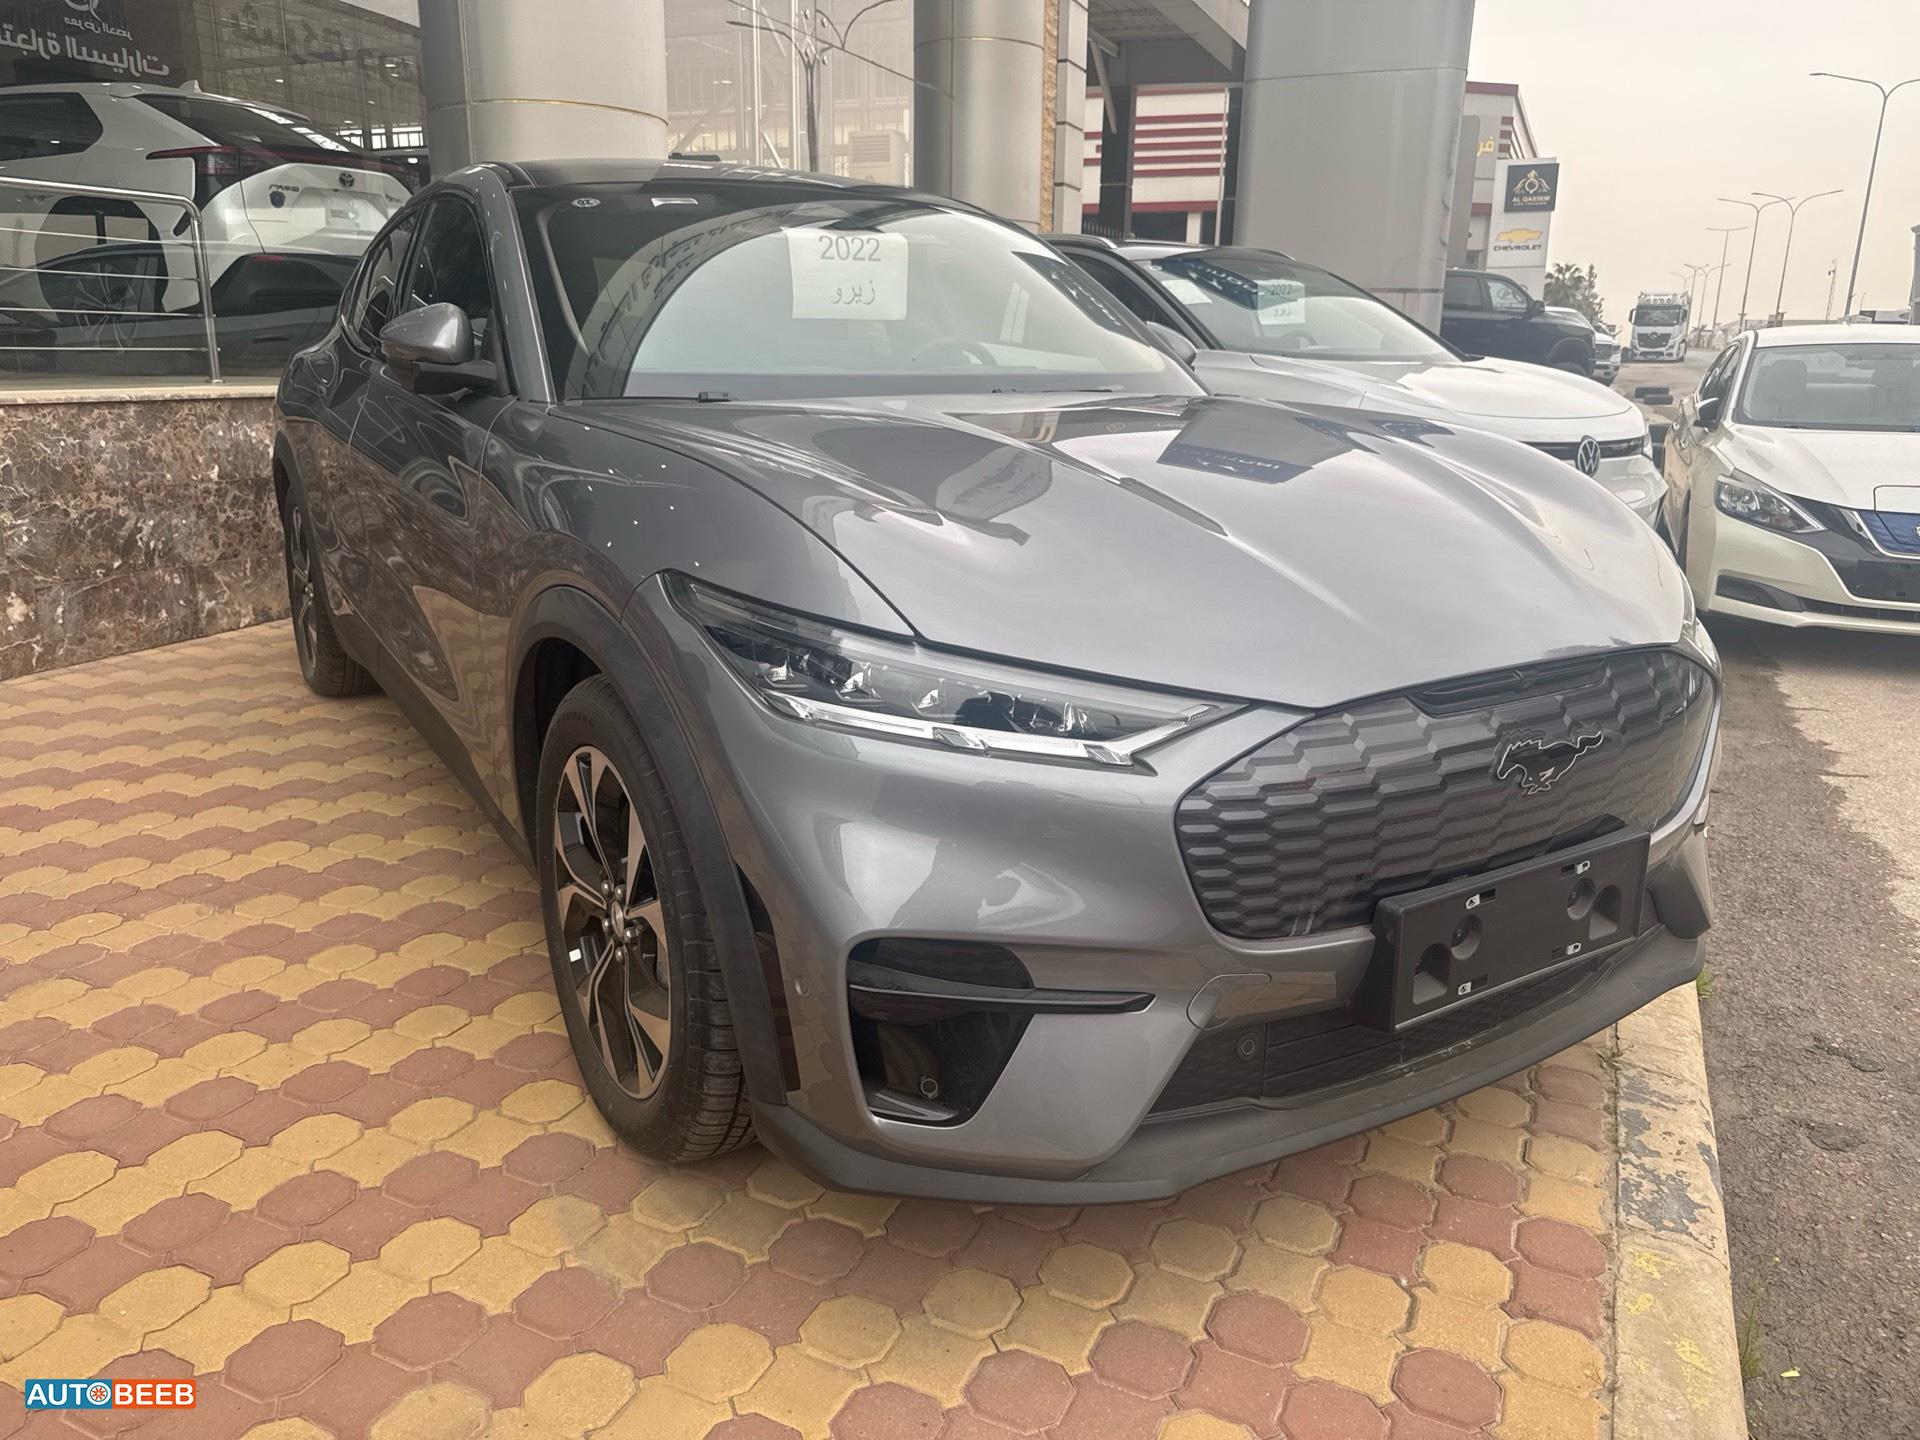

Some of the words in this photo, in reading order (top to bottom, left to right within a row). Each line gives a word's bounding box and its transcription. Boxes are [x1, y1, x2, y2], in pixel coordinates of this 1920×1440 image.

[819, 235, 882, 262] 2022
[1493, 244, 1542, 252] CHEVROLET
[830, 280, 876, 306] زيرو
